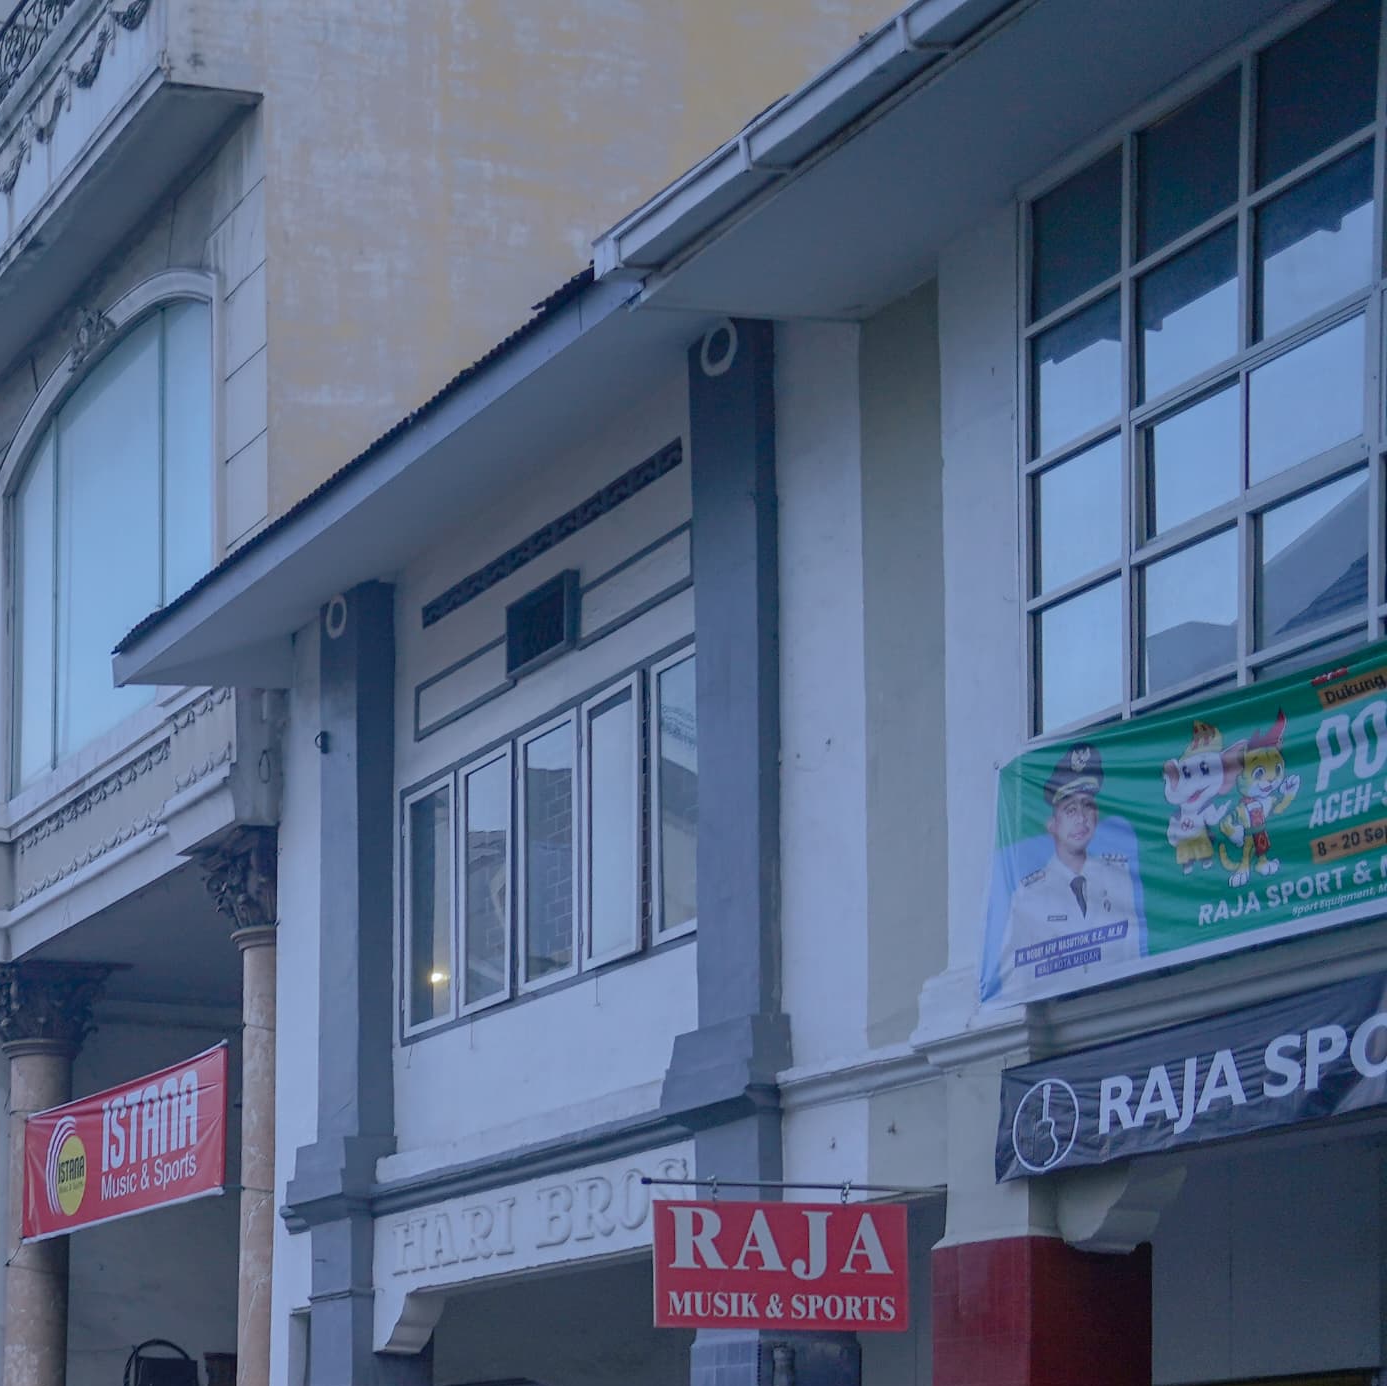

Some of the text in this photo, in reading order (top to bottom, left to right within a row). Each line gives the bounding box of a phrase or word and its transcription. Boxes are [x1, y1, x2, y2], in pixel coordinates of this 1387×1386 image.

[1317, 841, 1327, 858] 8
[1342, 831, 1360, 851] 20
[1198, 893, 1261, 926] RAJA
[1266, 866, 1346, 909] SPORT
[1353, 860, 1372, 884] &
[101, 1069, 199, 1173] ISTANA
[1099, 1048, 1247, 1135] RAJA
[57, 1155, 85, 1185] ISTANA
[101, 1151, 197, 1201] Music & Sports
[393, 1197, 516, 1277] HARI
[667, 1206, 894, 1280] RAJA
[667, 1291, 896, 1322] MUSIK & SPORTS
